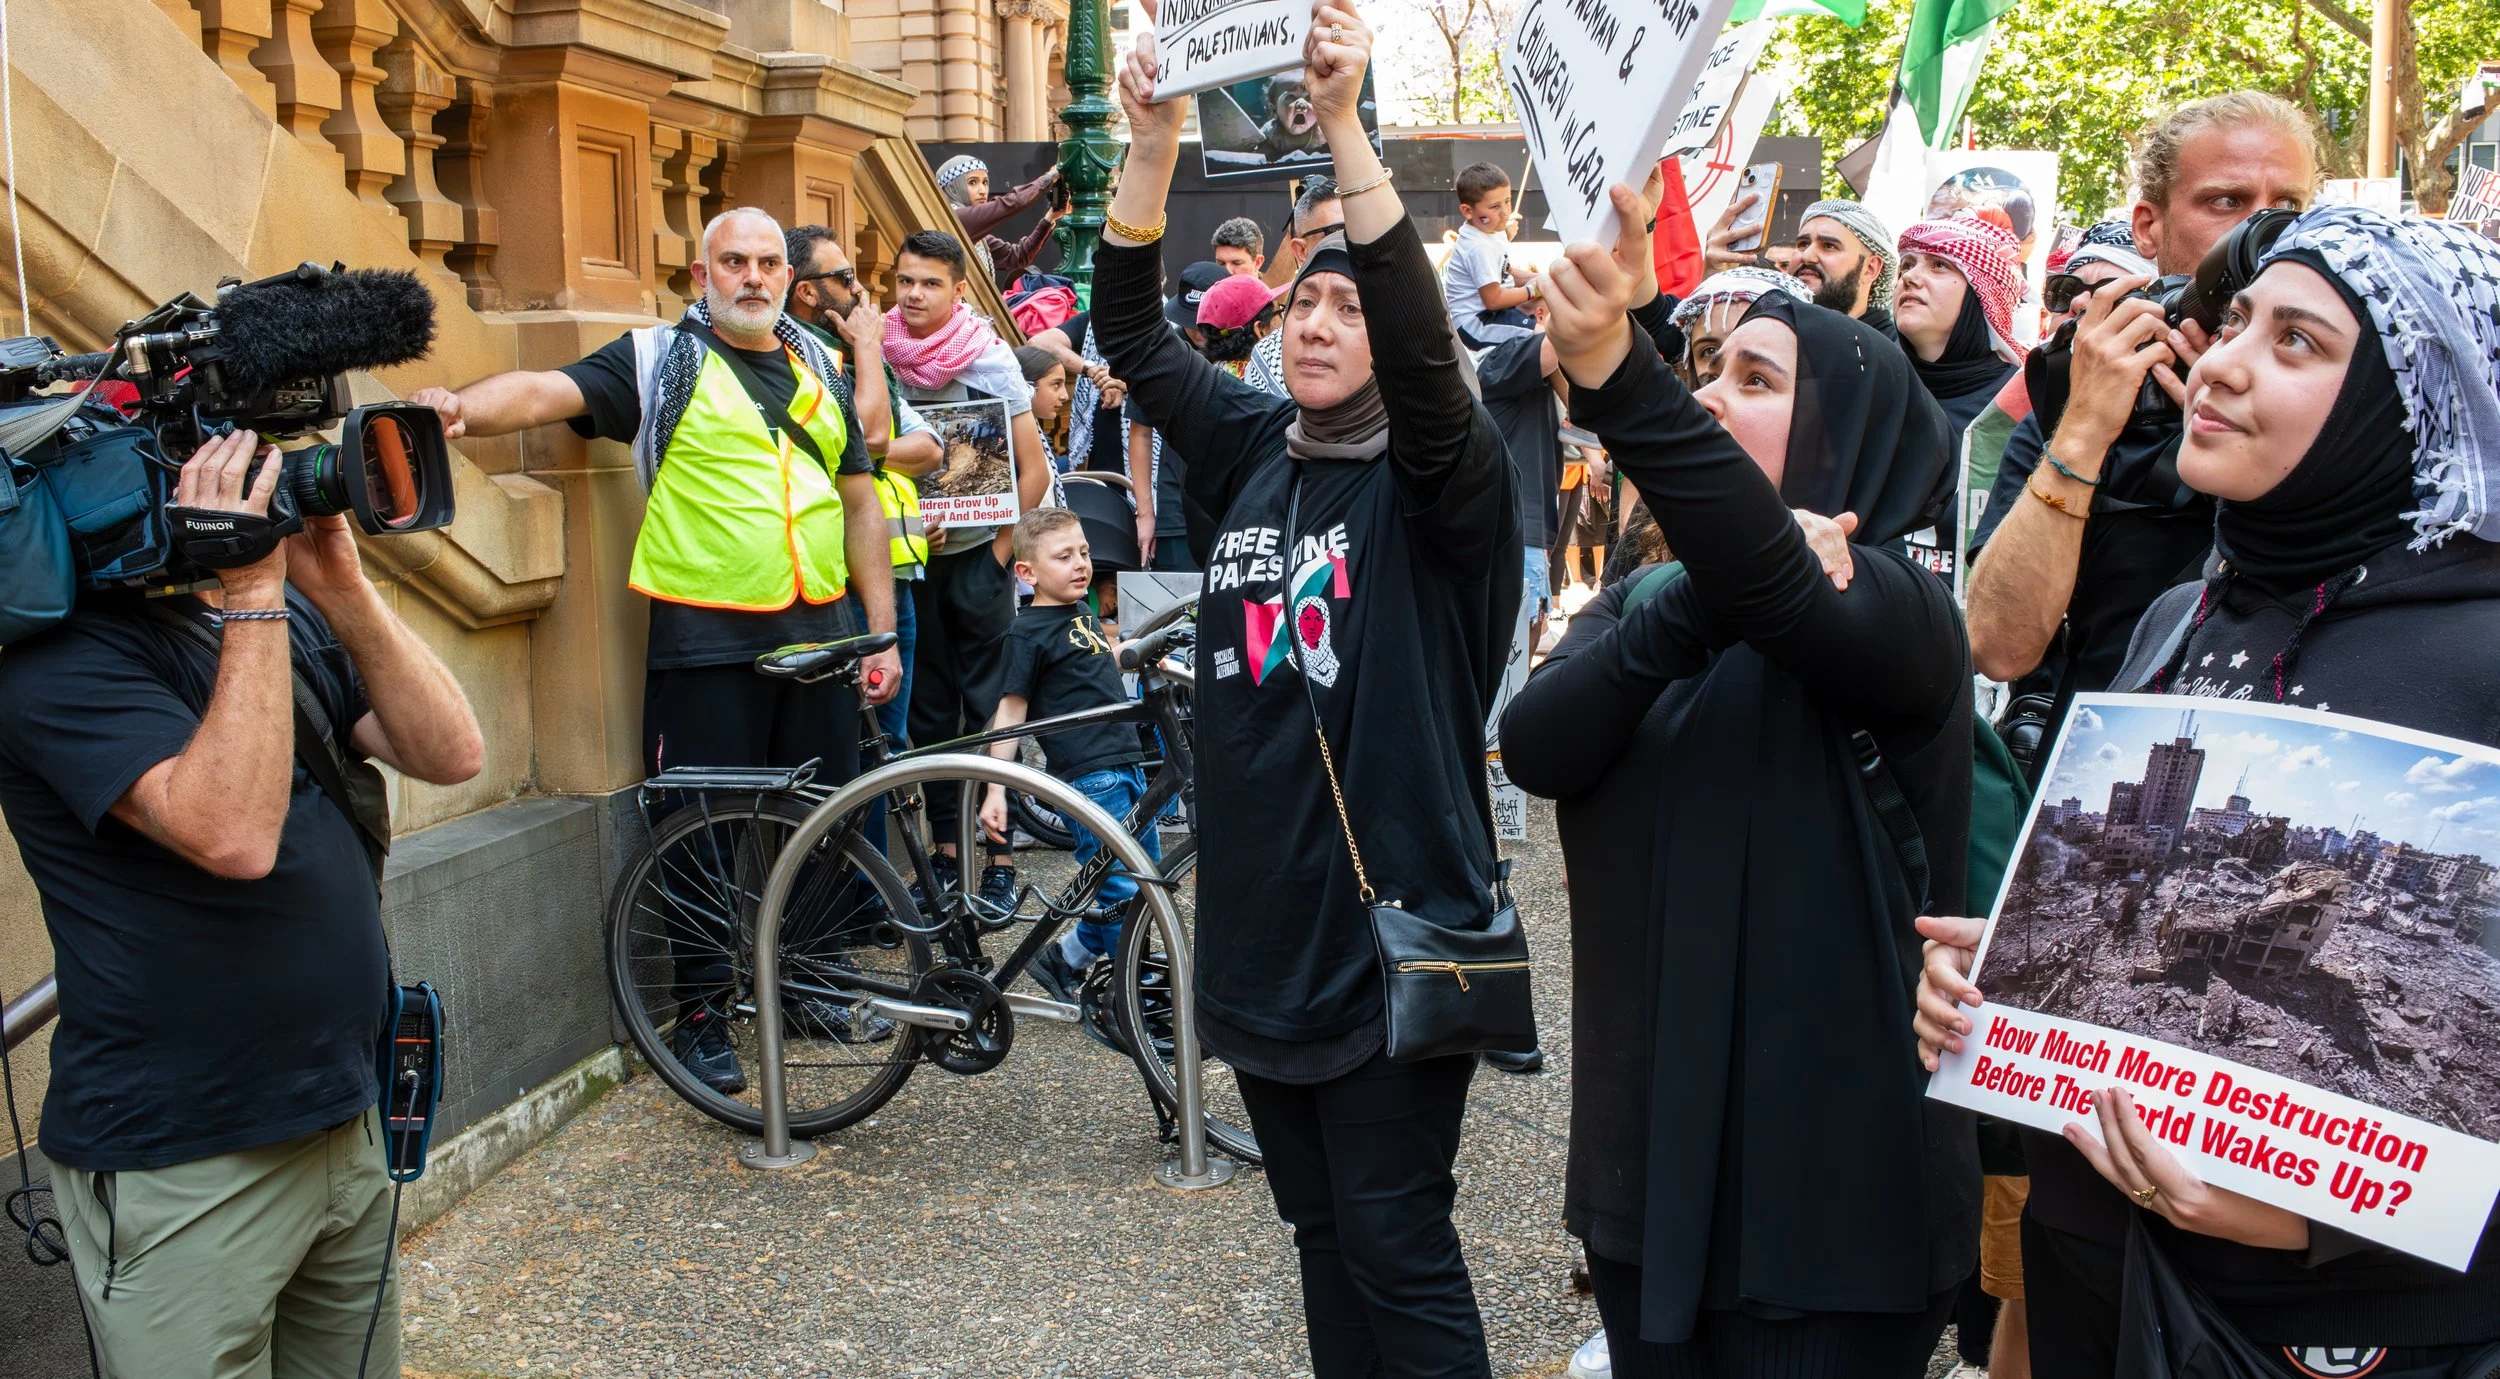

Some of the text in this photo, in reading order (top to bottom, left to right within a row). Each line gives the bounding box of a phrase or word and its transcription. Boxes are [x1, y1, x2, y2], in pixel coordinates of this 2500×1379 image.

[1186, 14, 1296, 72] PALESTINIANS.
[1619, 26, 1646, 86] &
[1517, 1, 1606, 220] CHILDREN IN GAZA
[185, 520, 235, 531] FUJINON
[949, 510, 970, 522] And
[973, 508, 1014, 521] Despair
[953, 498, 982, 510] Grow
[984, 496, 999, 509] Up
[1212, 527, 1281, 562] FREE
[2190, 676, 2230, 699] York
[1985, 1016, 2429, 1174] How Much More Destruction
[1970, 1055, 2413, 1218] Before The orld Wakes Up?
